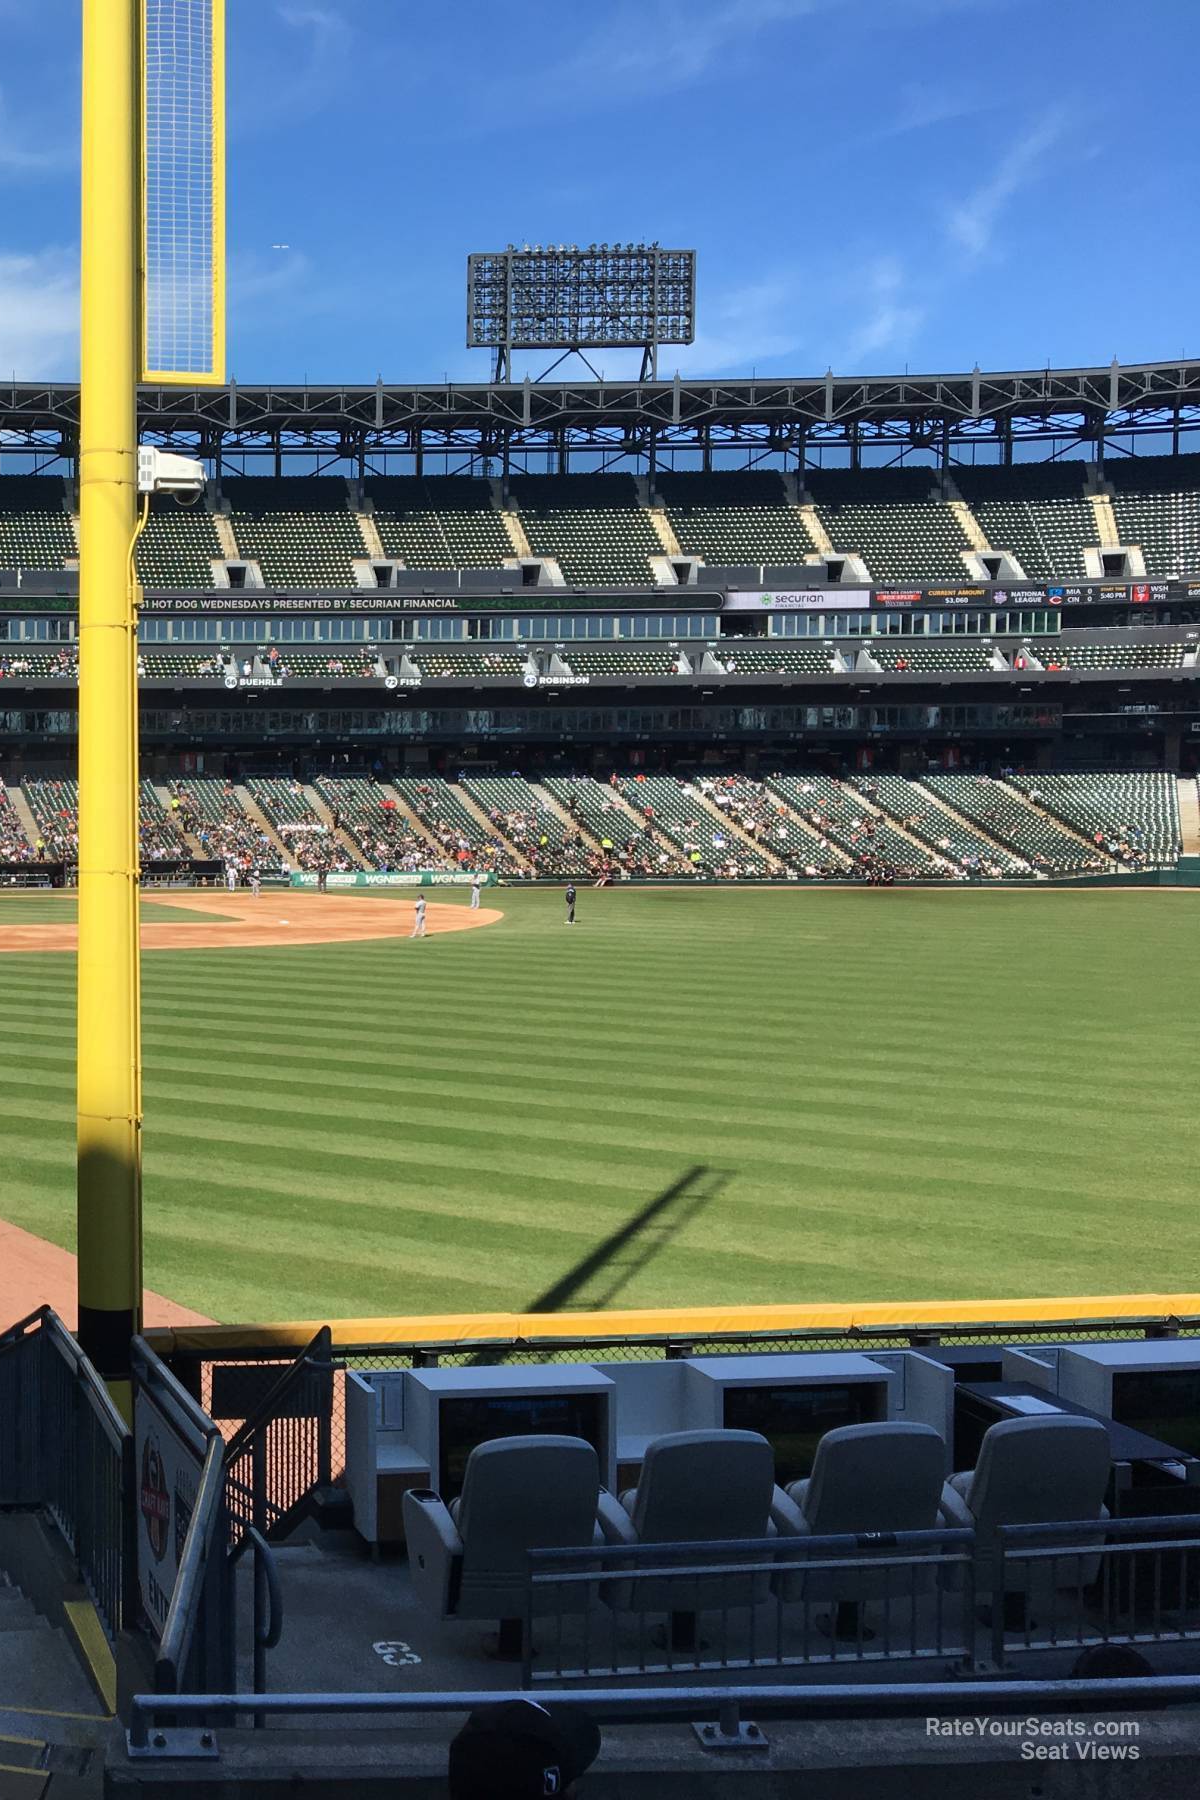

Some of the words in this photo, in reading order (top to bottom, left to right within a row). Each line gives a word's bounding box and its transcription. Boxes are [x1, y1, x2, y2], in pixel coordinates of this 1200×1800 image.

[775, 595, 824, 603] securian
[1100, 592, 1114, 600] 5:40
[152, 600, 173, 609] HOT
[175, 600, 197, 609] DOG
[201, 600, 271, 609] WEDNESDAYS
[273, 600, 332, 609] PRESENTED
[334, 600, 348, 609] BY
[350, 600, 401, 609] SECURIAN
[403, 599, 458, 608] FINANCIAL
[239, 678, 283, 686] BUEHRLE
[400, 678, 422, 686] FISK
[366, 874, 392, 884] WGN
[431, 874, 457, 884] WGN
